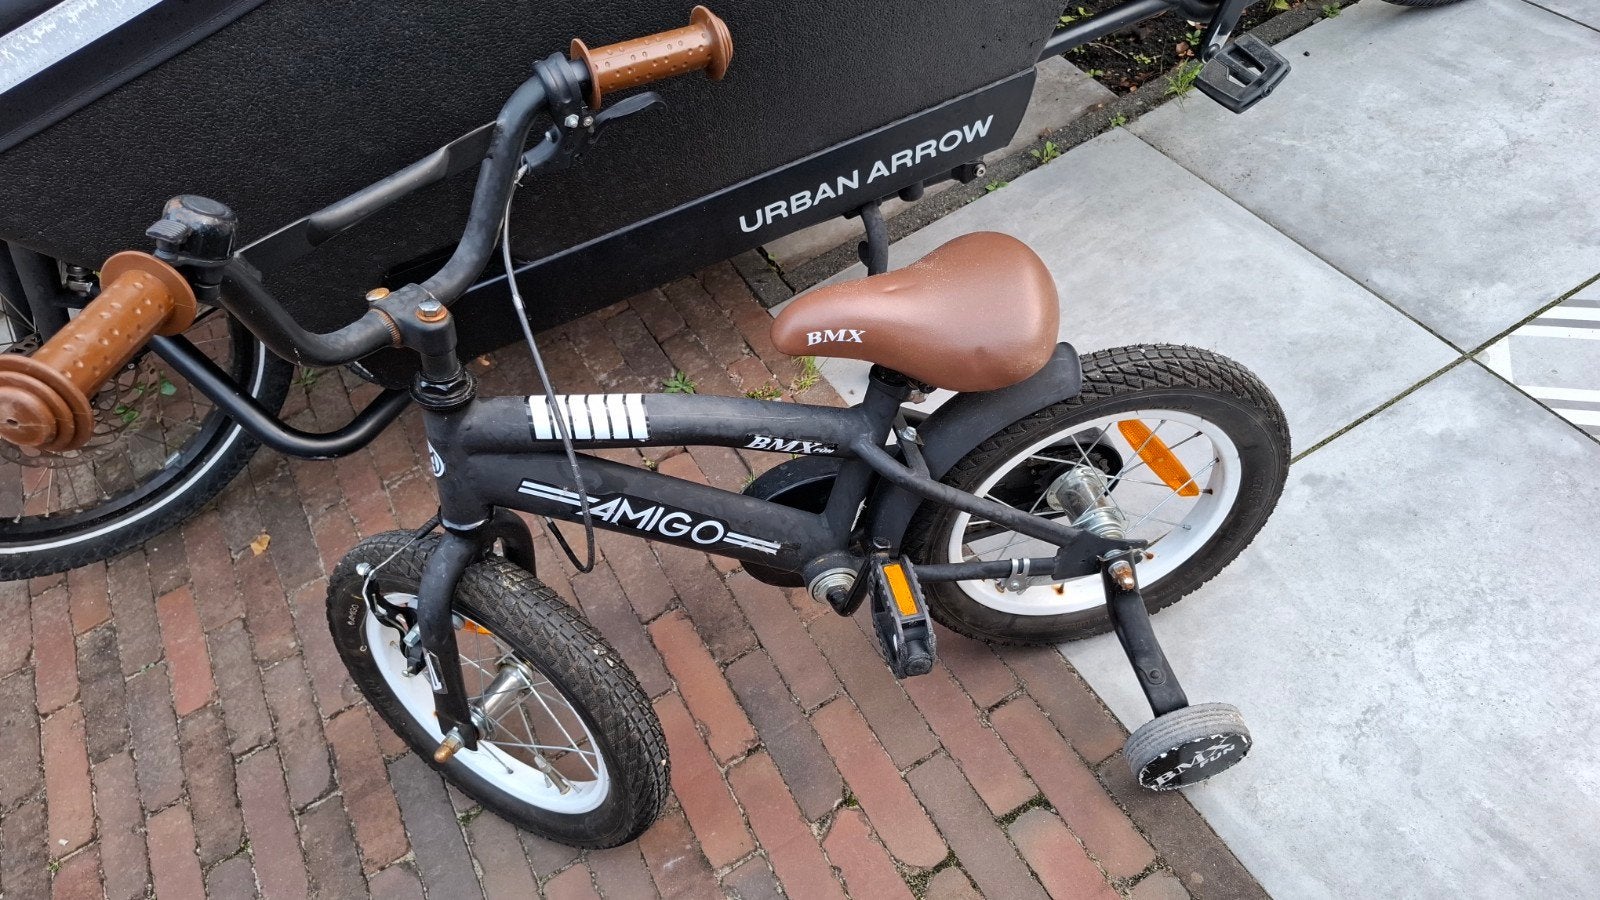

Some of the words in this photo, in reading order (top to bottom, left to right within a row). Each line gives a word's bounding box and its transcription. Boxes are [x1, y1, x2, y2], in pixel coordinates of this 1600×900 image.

[739, 169, 859, 233] URBAN
[867, 115, 994, 184] ARROW
[806, 328, 866, 347] BMX
[744, 436, 822, 454] BMX
[590, 497, 726, 546] AMIGO
[1154, 737, 1230, 786] BMX
